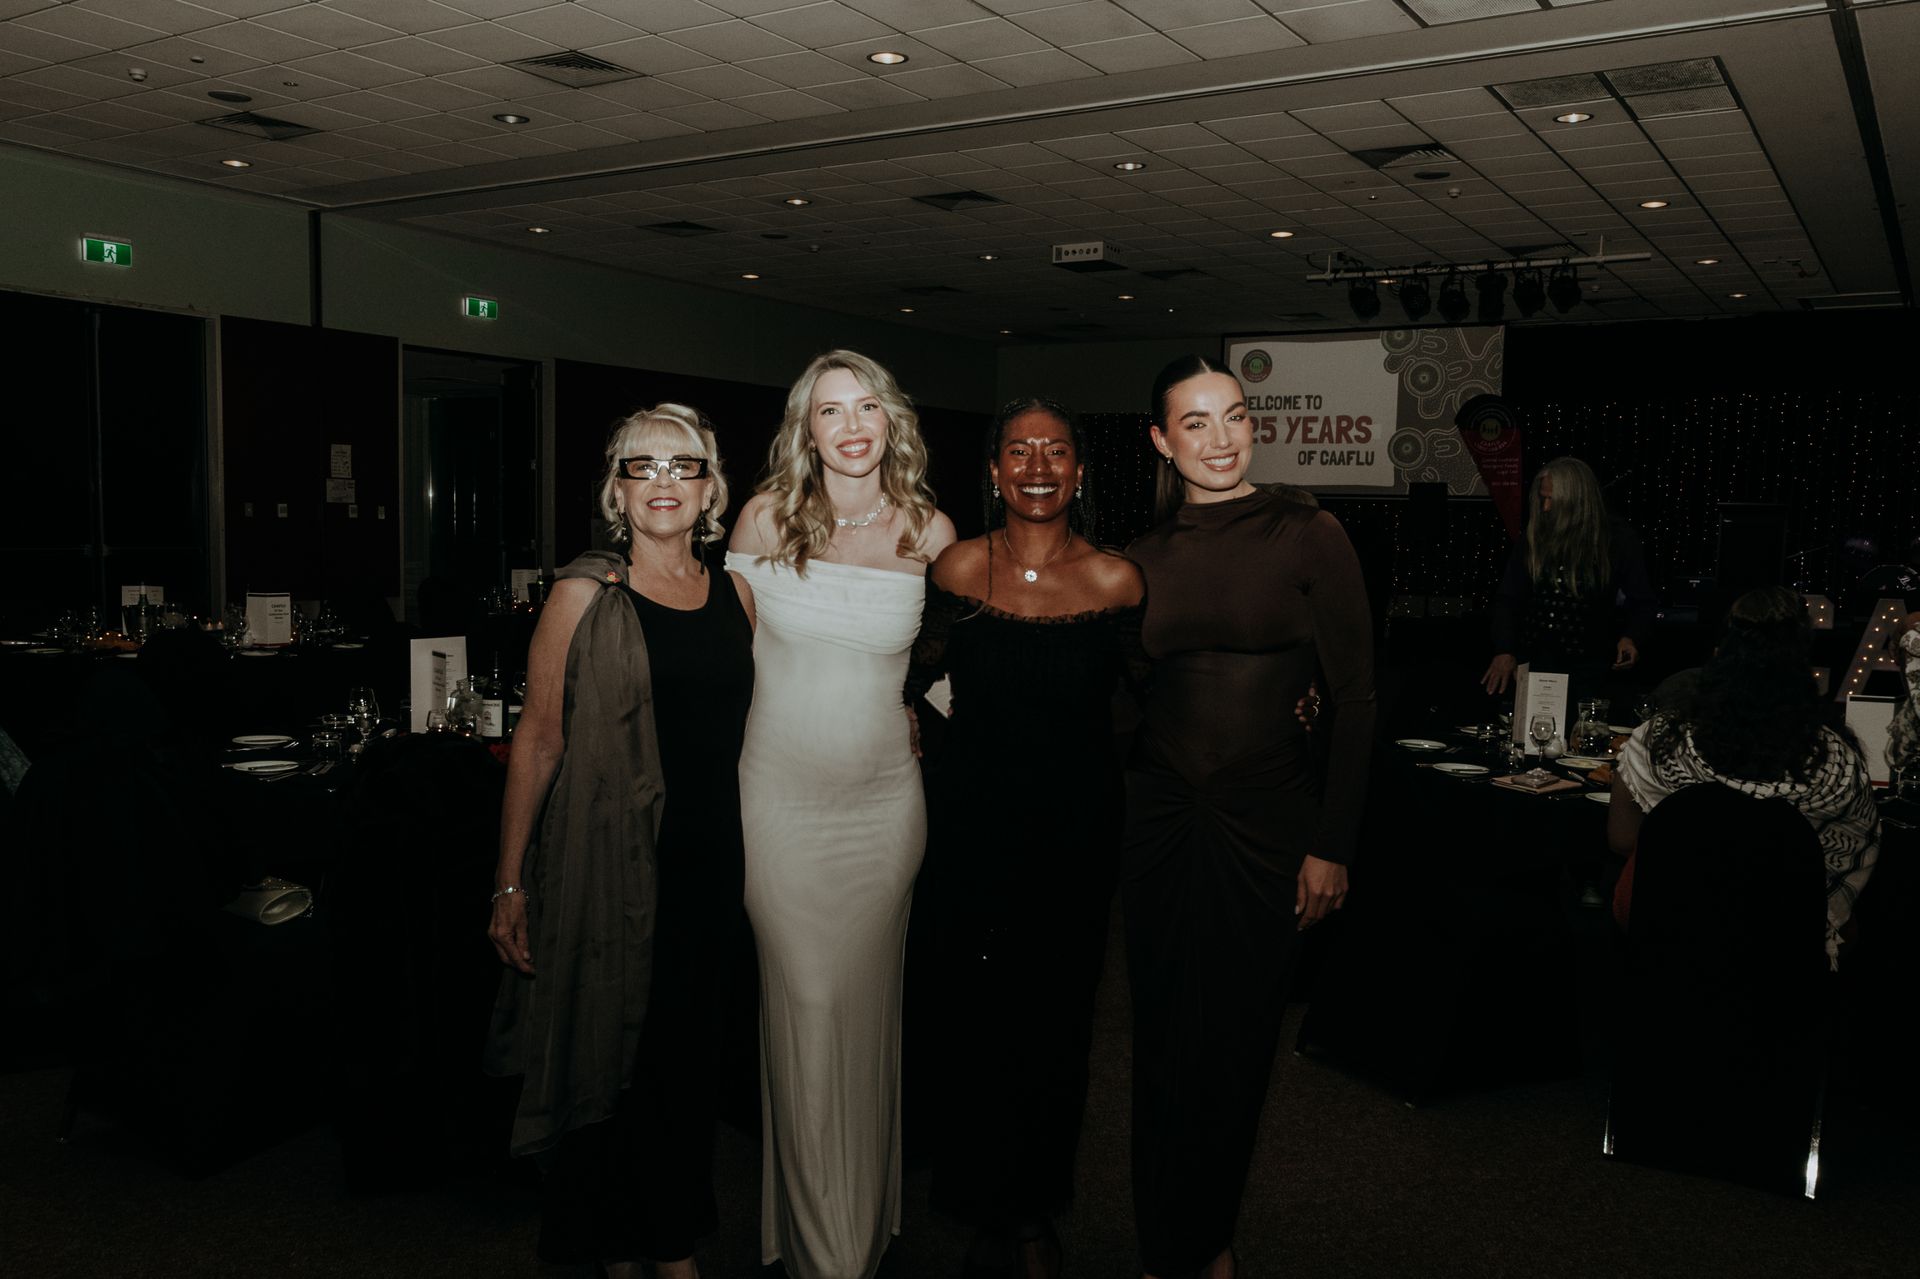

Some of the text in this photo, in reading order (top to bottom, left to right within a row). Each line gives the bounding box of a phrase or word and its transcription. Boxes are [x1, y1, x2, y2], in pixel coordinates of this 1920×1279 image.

[1305, 394, 1322, 410] TO
[1284, 414, 1373, 444] YEARS
[1298, 450, 1375, 466] OF CAAFLU
